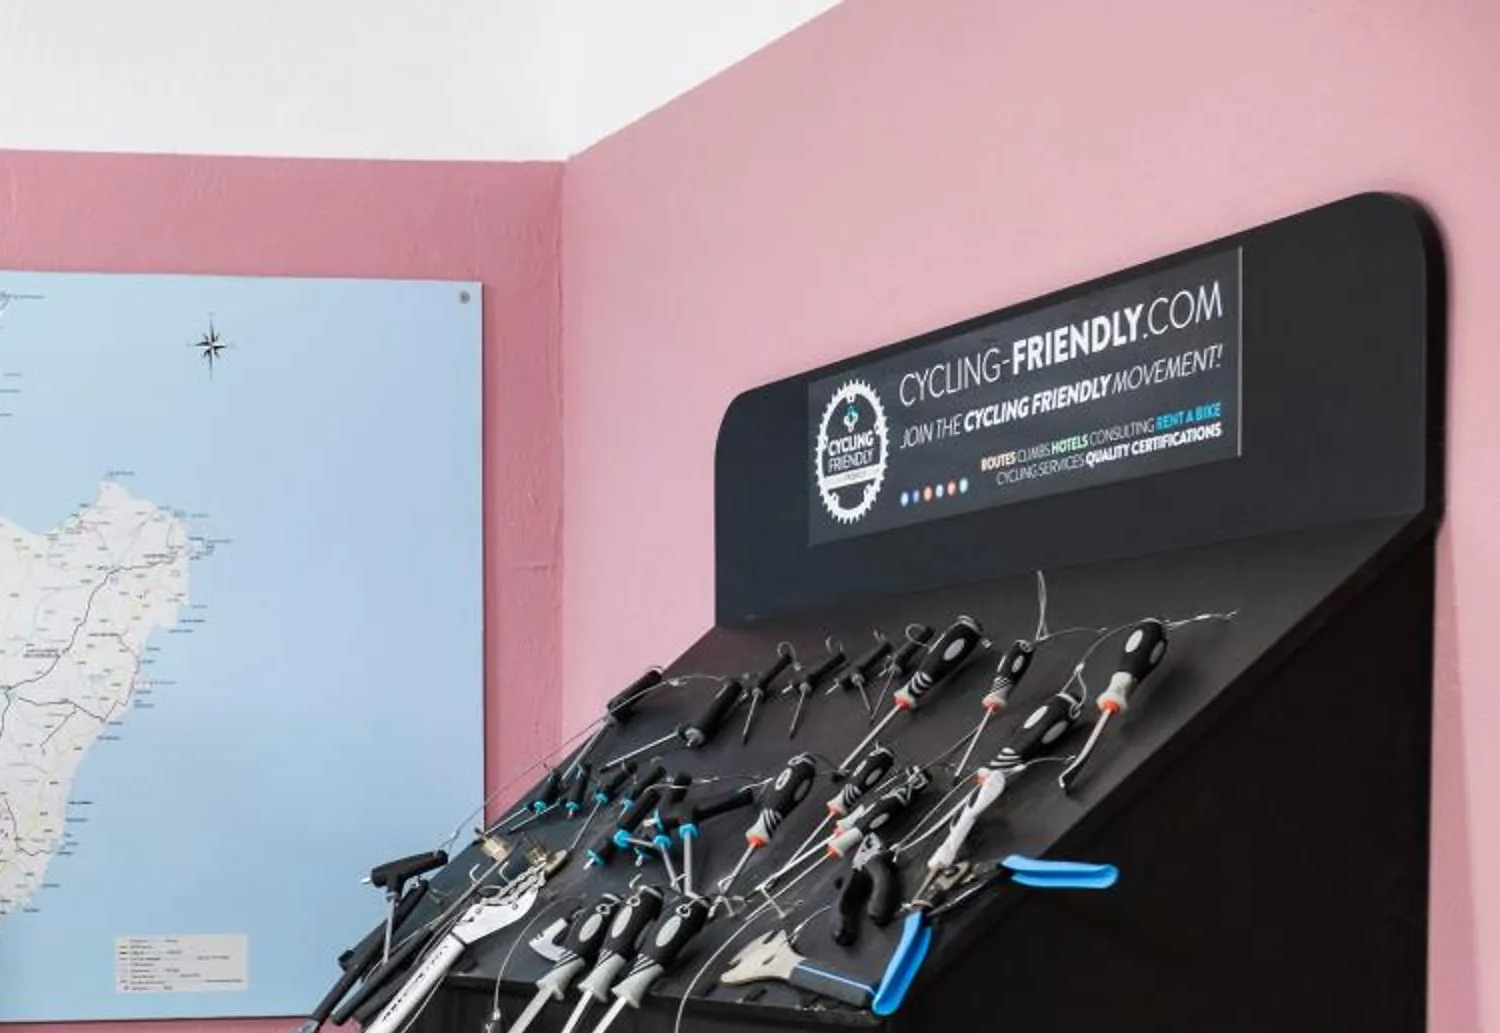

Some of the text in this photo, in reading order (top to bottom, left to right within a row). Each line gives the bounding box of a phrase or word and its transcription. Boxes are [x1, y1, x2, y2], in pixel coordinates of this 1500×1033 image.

[900, 281, 1223, 407] CYCLING-FRIENDLY.COM
[900, 344, 1223, 450] JOIN THE CYCLING FRIENDLY MOVEMENT!
[981, 451, 1016, 472] ROUTES
[1051, 434, 1088, 454] HOTELS
[1089, 418, 1155, 446] CONSULTING
[1156, 410, 1184, 432] RENT
[1185, 408, 1194, 424] A
[1196, 402, 1221, 421] BIKE
[996, 422, 1222, 486] CYCLING SERVICES QUALITY CERTIFICATIONS
